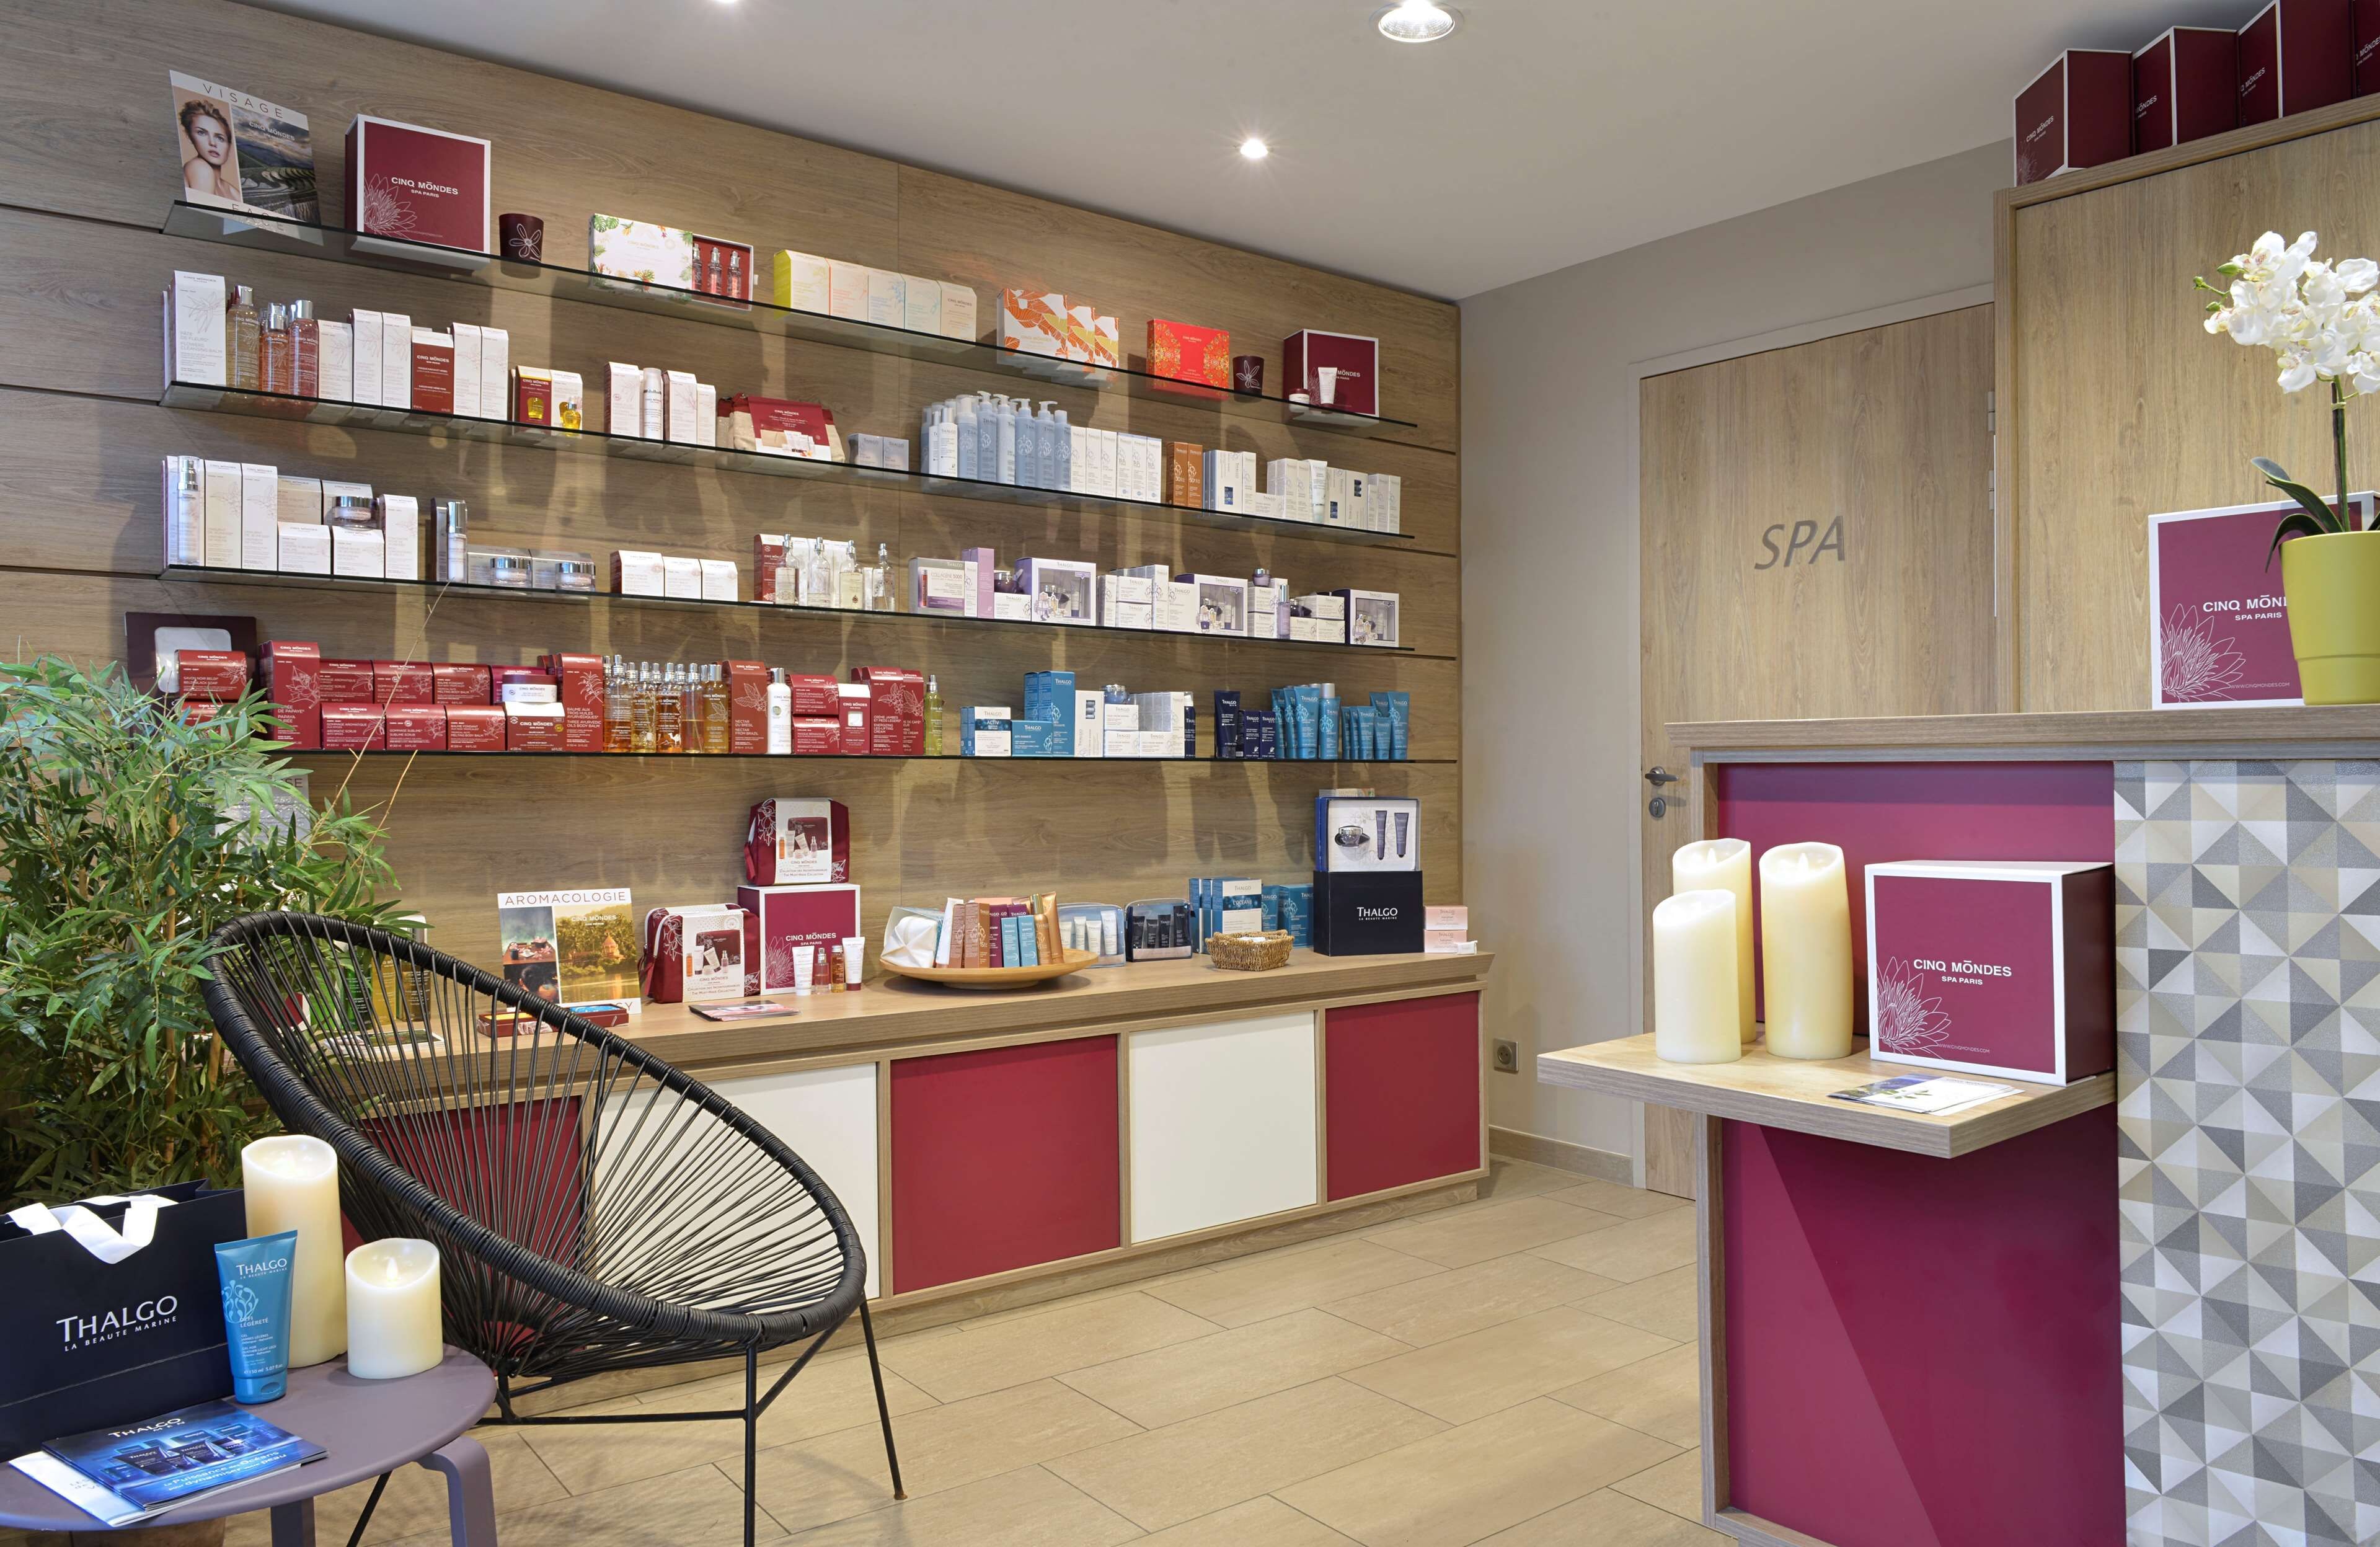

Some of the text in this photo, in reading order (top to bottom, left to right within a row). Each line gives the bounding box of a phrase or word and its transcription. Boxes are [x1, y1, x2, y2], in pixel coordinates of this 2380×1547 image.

[203, 83, 283, 118] VISAGE
[249, 122, 265, 131] CINQ
[391, 177, 415, 187] CINQ
[1754, 515, 1845, 570] SPA
[2203, 595, 2287, 612] CINQ MŌN
[505, 892, 626, 906] AROMACOLOGIE
[1357, 907, 1398, 917] THALGO
[1913, 959, 1947, 972] CINQ
[236, 1258, 287, 1275] THALGO
[56, 1295, 178, 1342] THALGO
[65, 1316, 177, 1352] LA BEAUTE MARINE
[108, 1418, 181, 1438] THALGO
[153, 1421, 185, 1432] MEN
[173, 1467, 227, 1484] Puissance
[240, 1451, 279, 1465] Océans
[185, 1468, 241, 1486] dynamiser
[261, 1454, 287, 1465] peau
